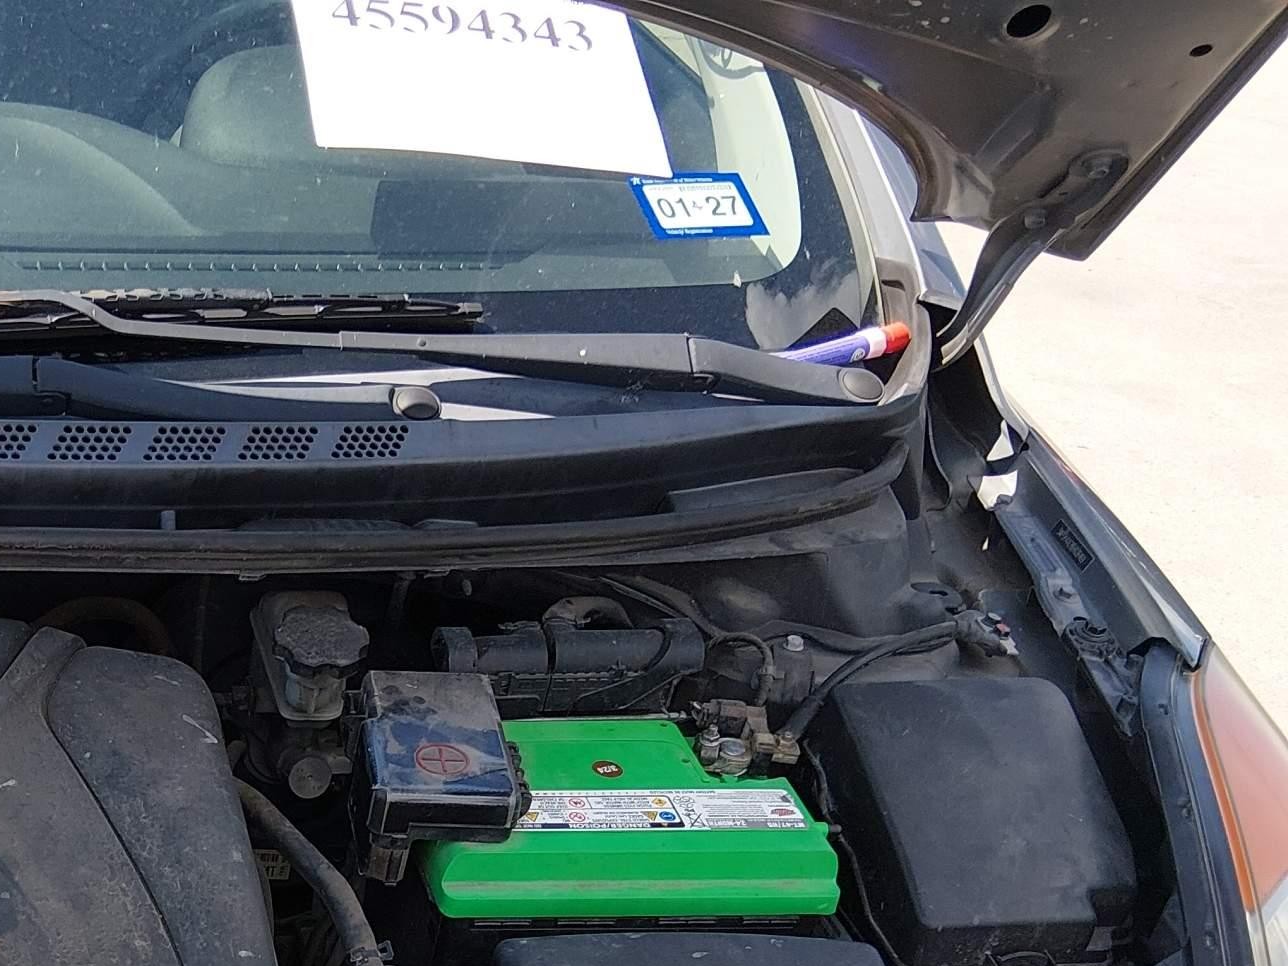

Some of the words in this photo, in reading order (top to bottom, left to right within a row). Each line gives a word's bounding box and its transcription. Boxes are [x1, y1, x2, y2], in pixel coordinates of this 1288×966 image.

[331, 0, 593, 51] 45594343
[656, 198, 691, 218] 01
[705, 195, 737, 216] 27
